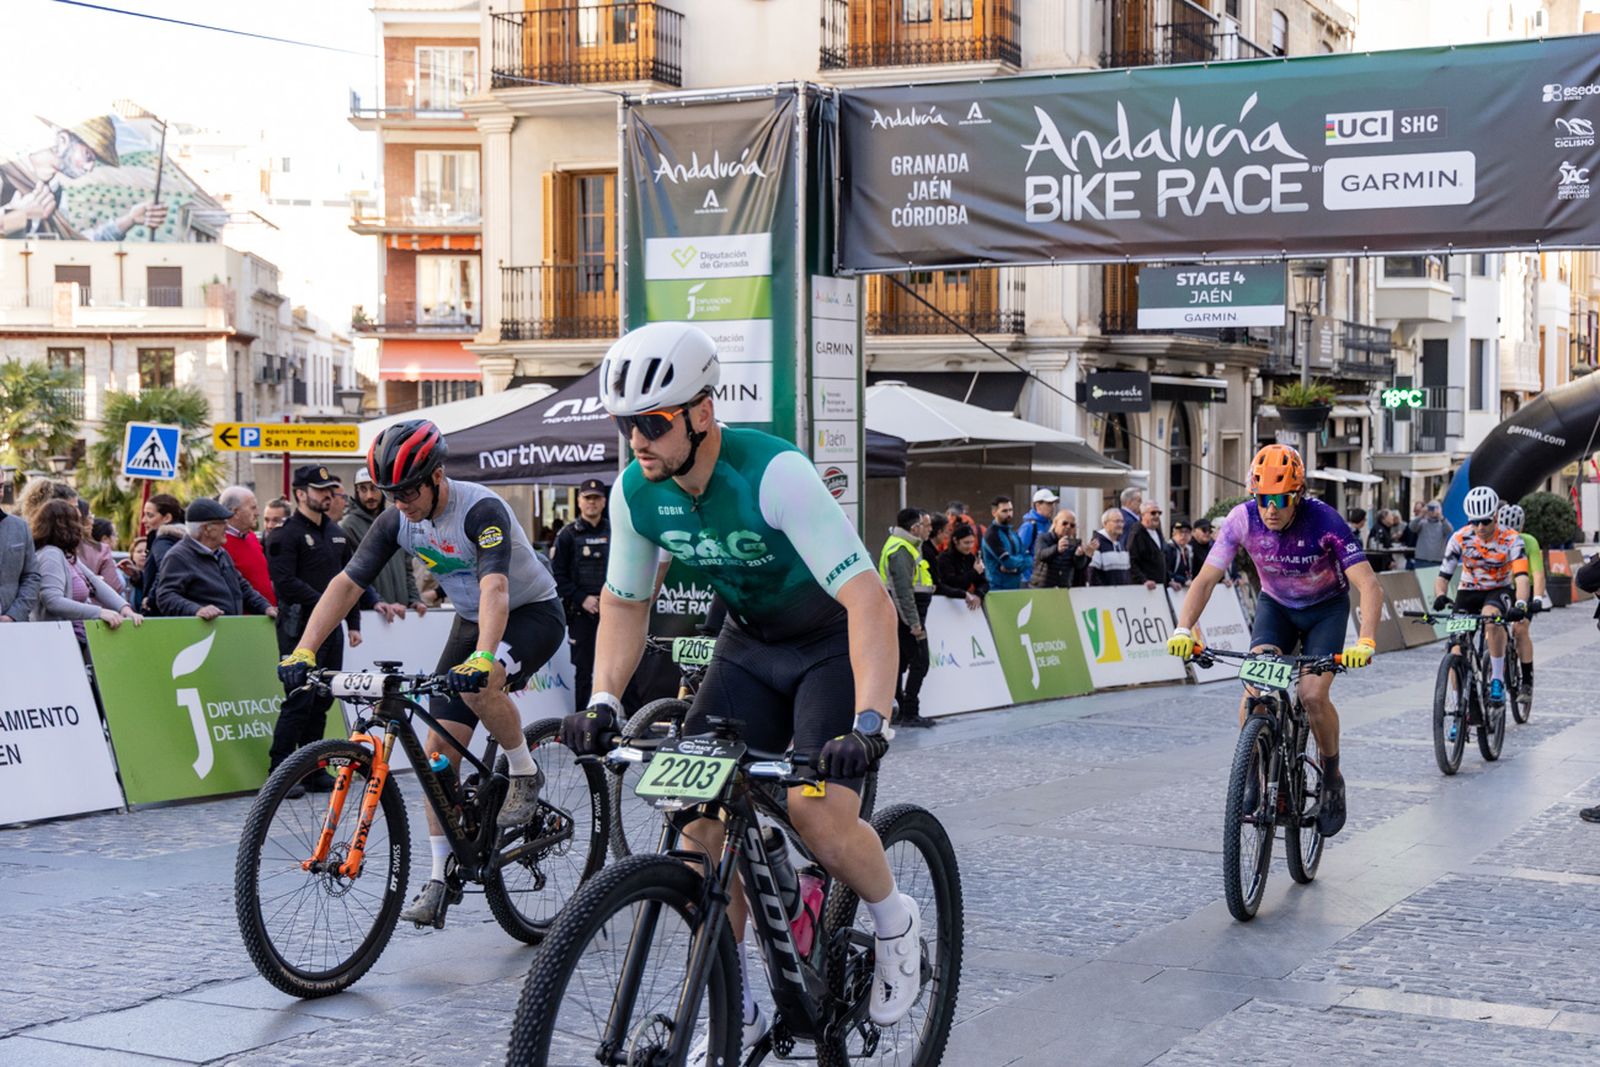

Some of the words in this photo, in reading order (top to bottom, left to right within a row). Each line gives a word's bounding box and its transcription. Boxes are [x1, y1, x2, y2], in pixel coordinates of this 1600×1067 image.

[870, 105, 949, 130] Andalucía
[1337, 116, 1388, 139] UCI
[1400, 114, 1439, 134] SHC
[1020, 91, 1309, 173] Andalucía
[1554, 139, 1595, 148] CICLISMO
[653, 147, 767, 185] Andalucía
[891, 152, 970, 176] GRANADA
[907, 175, 952, 201] JAÉN
[1340, 169, 1459, 193] GARMIN
[1025, 171, 1142, 223] BIKE
[1157, 162, 1310, 218] RACE
[1311, 165, 1323, 173] BY
[891, 202, 969, 227] CÓRDOBA
[700, 250, 747, 262] Diputación
[700, 261, 711, 270] de
[713, 259, 749, 269] Granada
[1176, 271, 1231, 286] STAGE
[1233, 270, 1246, 285] 4
[1189, 287, 1233, 304] JAÉN
[1184, 312, 1238, 323] GARMIN
[816, 341, 854, 355] GARMIN
[711, 384, 758, 402] MIN
[265, 437, 289, 447] San
[296, 437, 356, 448] Francisco
[1506, 424, 1567, 447] garmin.com
[658, 506, 685, 515] GOBIK
[825, 552, 860, 586] JEREZ
[656, 582, 715, 600] Andalucí
[656, 600, 686, 614] BIKE
[1117, 607, 1168, 647] Jaén
[678, 639, 711, 660] 2206
[1247, 661, 1286, 683] 2214
[212, 726, 236, 742] DE
[238, 719, 274, 740] JAÉN
[649, 756, 722, 790] 2203
[593, 792, 602, 817] SWISS
[595, 818, 602, 833] DT
[391, 844, 401, 873] SWISS
[389, 875, 399, 893] DT
[744, 827, 808, 993] SCOTT
